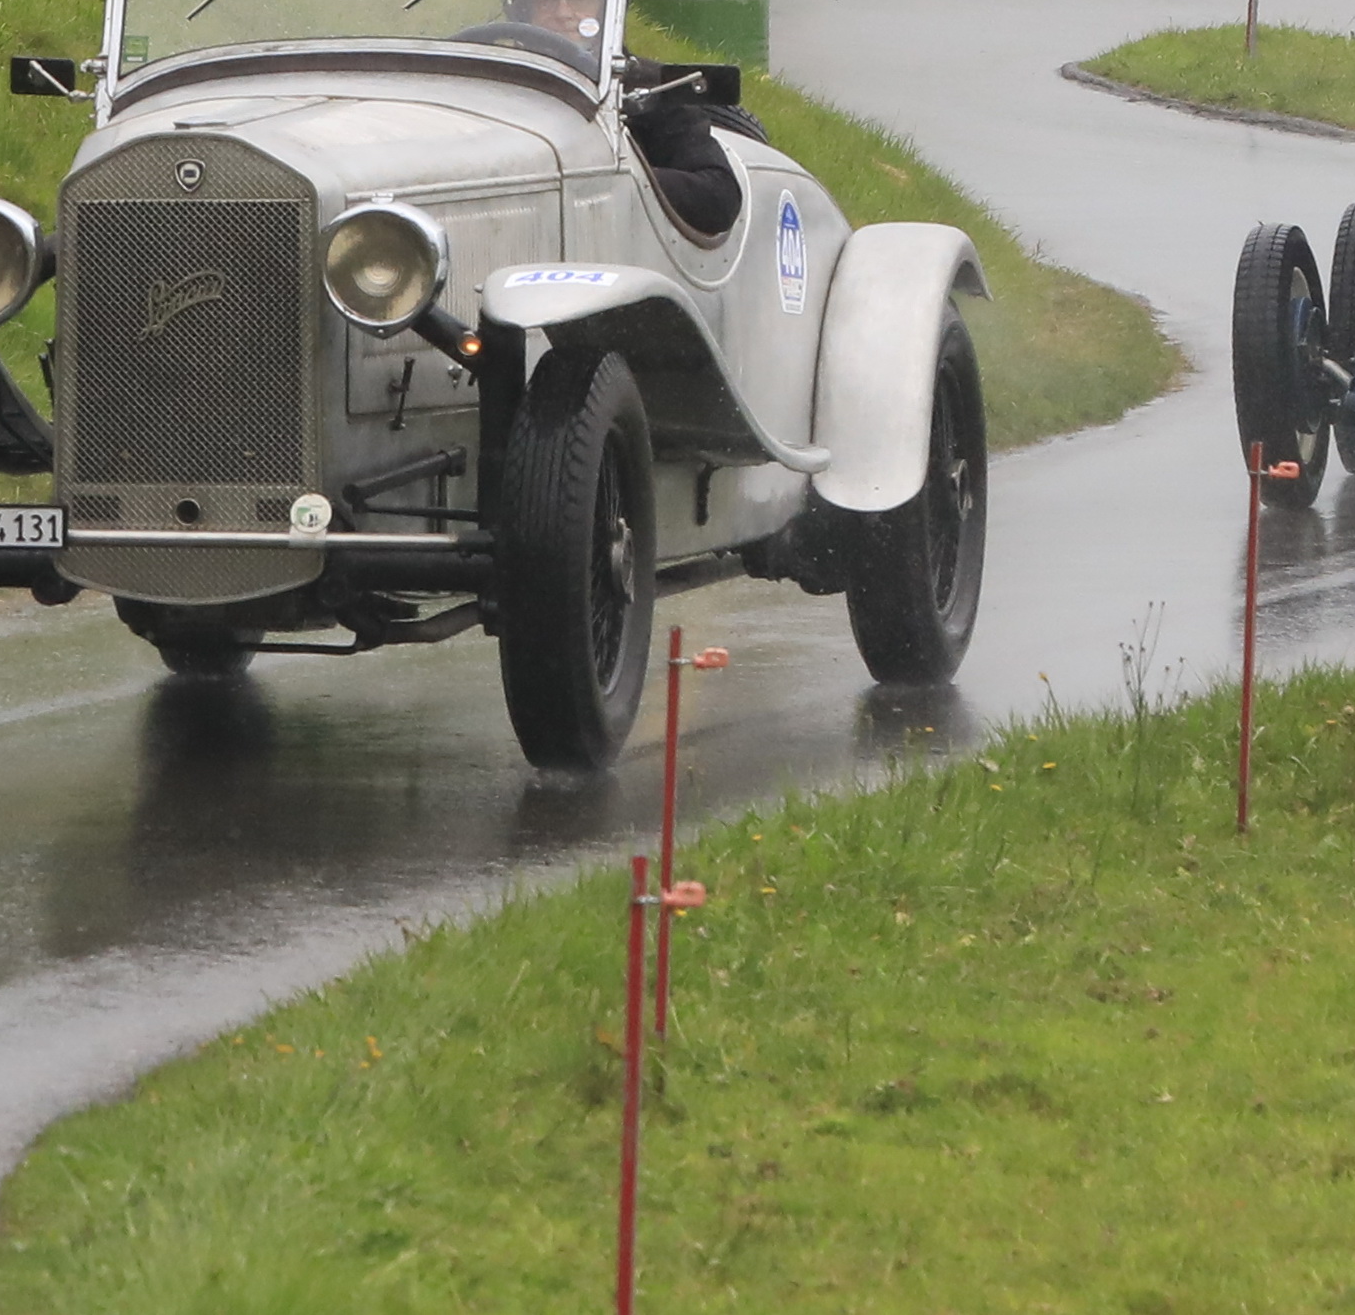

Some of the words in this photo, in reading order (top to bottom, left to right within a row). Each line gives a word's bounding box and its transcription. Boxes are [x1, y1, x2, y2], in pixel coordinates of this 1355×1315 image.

[782, 227, 802, 275] 404
[514, 270, 605, 283] 404
[13, 514, 60, 543] 131
